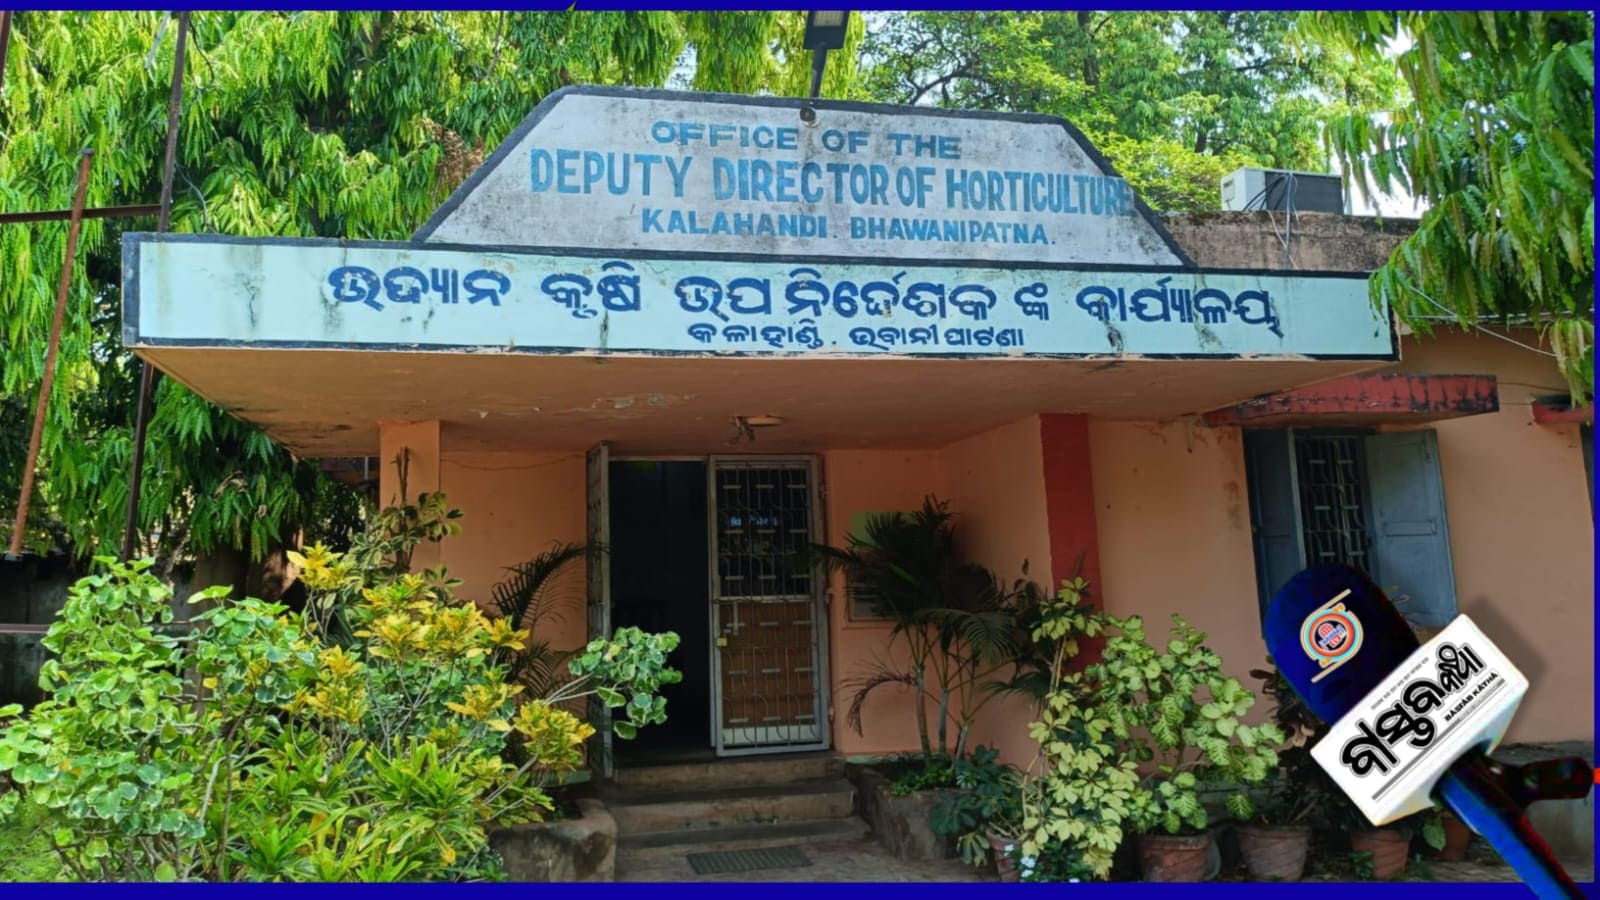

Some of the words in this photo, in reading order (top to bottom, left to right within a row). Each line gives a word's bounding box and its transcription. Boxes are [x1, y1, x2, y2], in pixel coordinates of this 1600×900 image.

[651, 120, 799, 150] OFFICE
[821, 129, 870, 153] OF
[887, 133, 961, 160] THE
[530, 148, 692, 198] DEPUTY
[713, 156, 889, 206] DIRECTOR
[896, 165, 936, 209] OF
[945, 167, 1137, 218] HORTICULTURE
[328, 265, 511, 313] ଉଦ୍ୟାନ
[541, 260, 641, 319] କୃଷି
